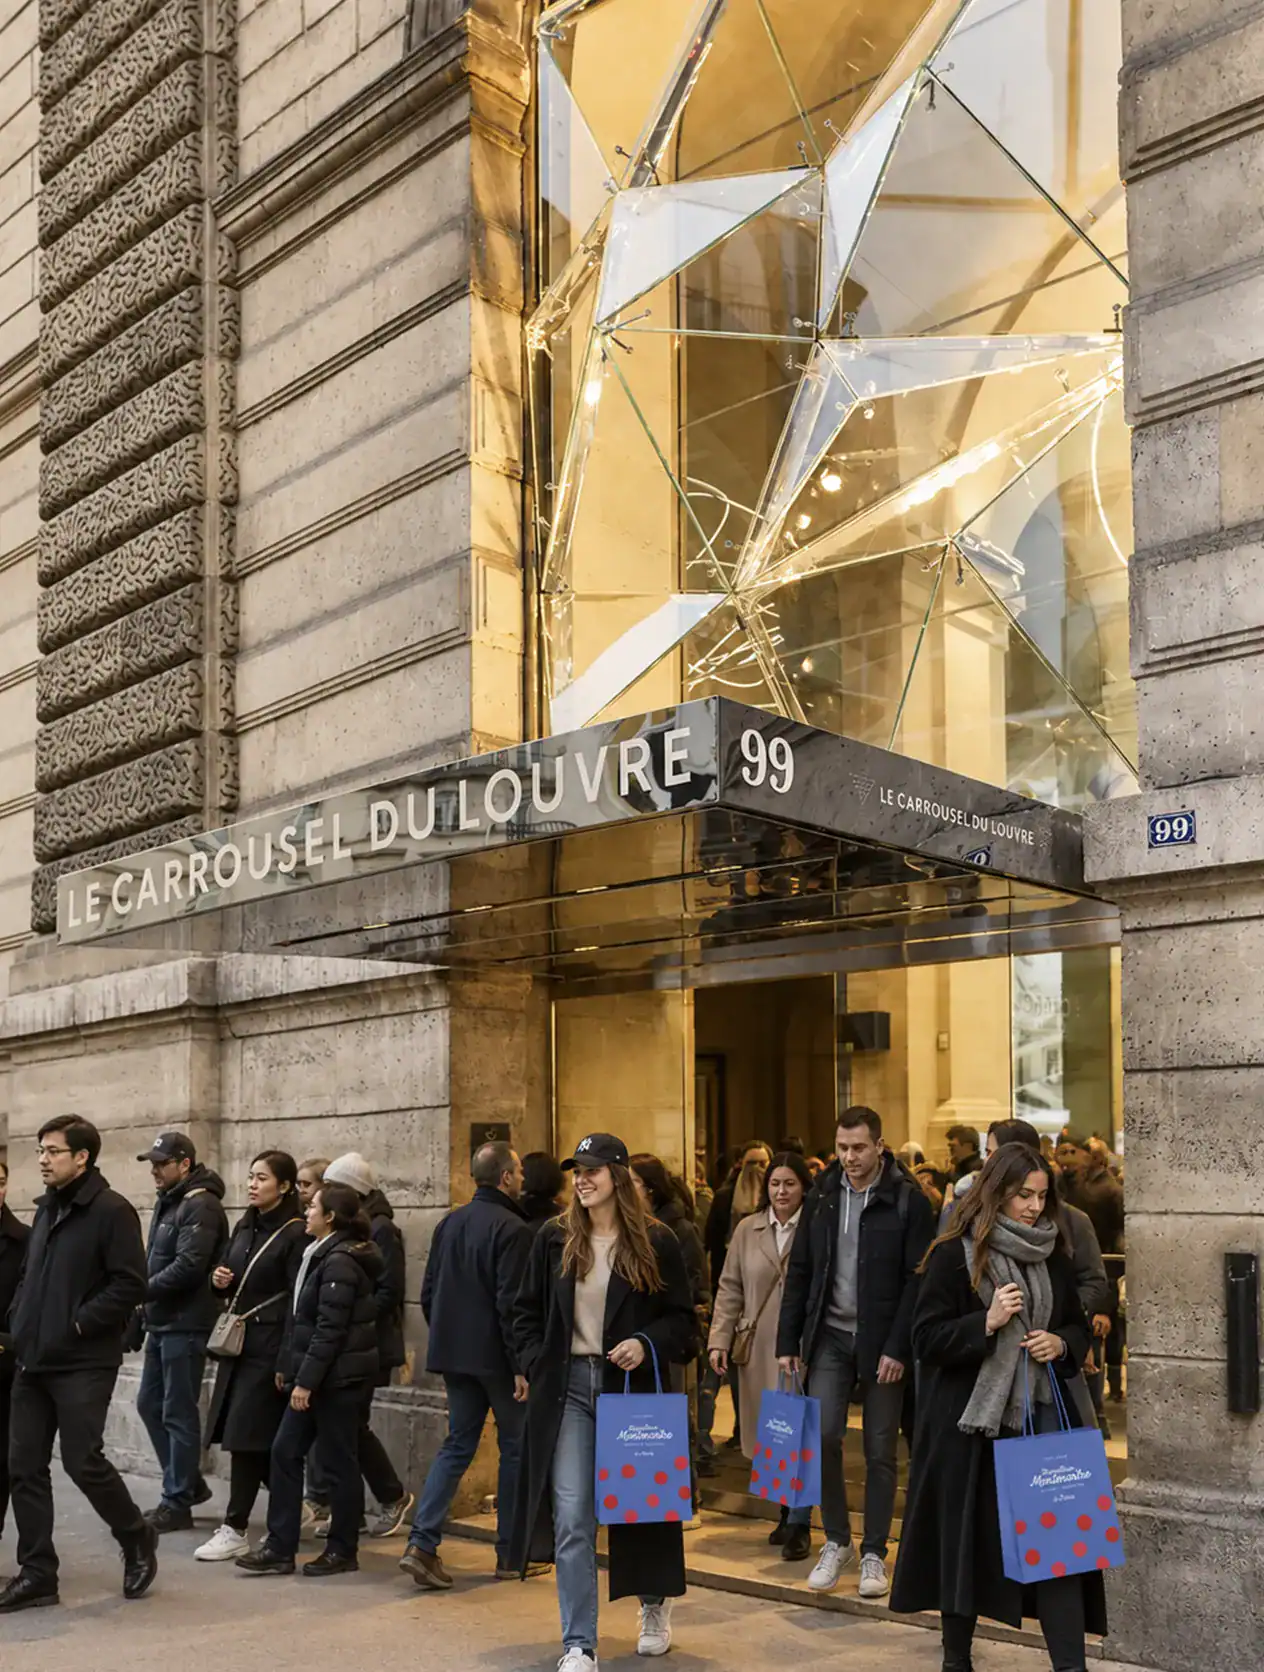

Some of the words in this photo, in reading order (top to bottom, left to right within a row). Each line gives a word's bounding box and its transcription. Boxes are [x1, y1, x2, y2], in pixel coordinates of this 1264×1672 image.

[740, 728, 795, 794] 99
[67, 881, 101, 928] LE
[111, 812, 352, 915] CARROUSEL
[370, 787, 436, 852] DU
[459, 727, 692, 831] LOUVRE
[879, 786, 894, 806] LE
[897, 792, 971, 828] CARROUSEL
[972, 814, 988, 832] DU
[991, 820, 1036, 846] LOUVRE
[1155, 817, 1189, 842] 99
